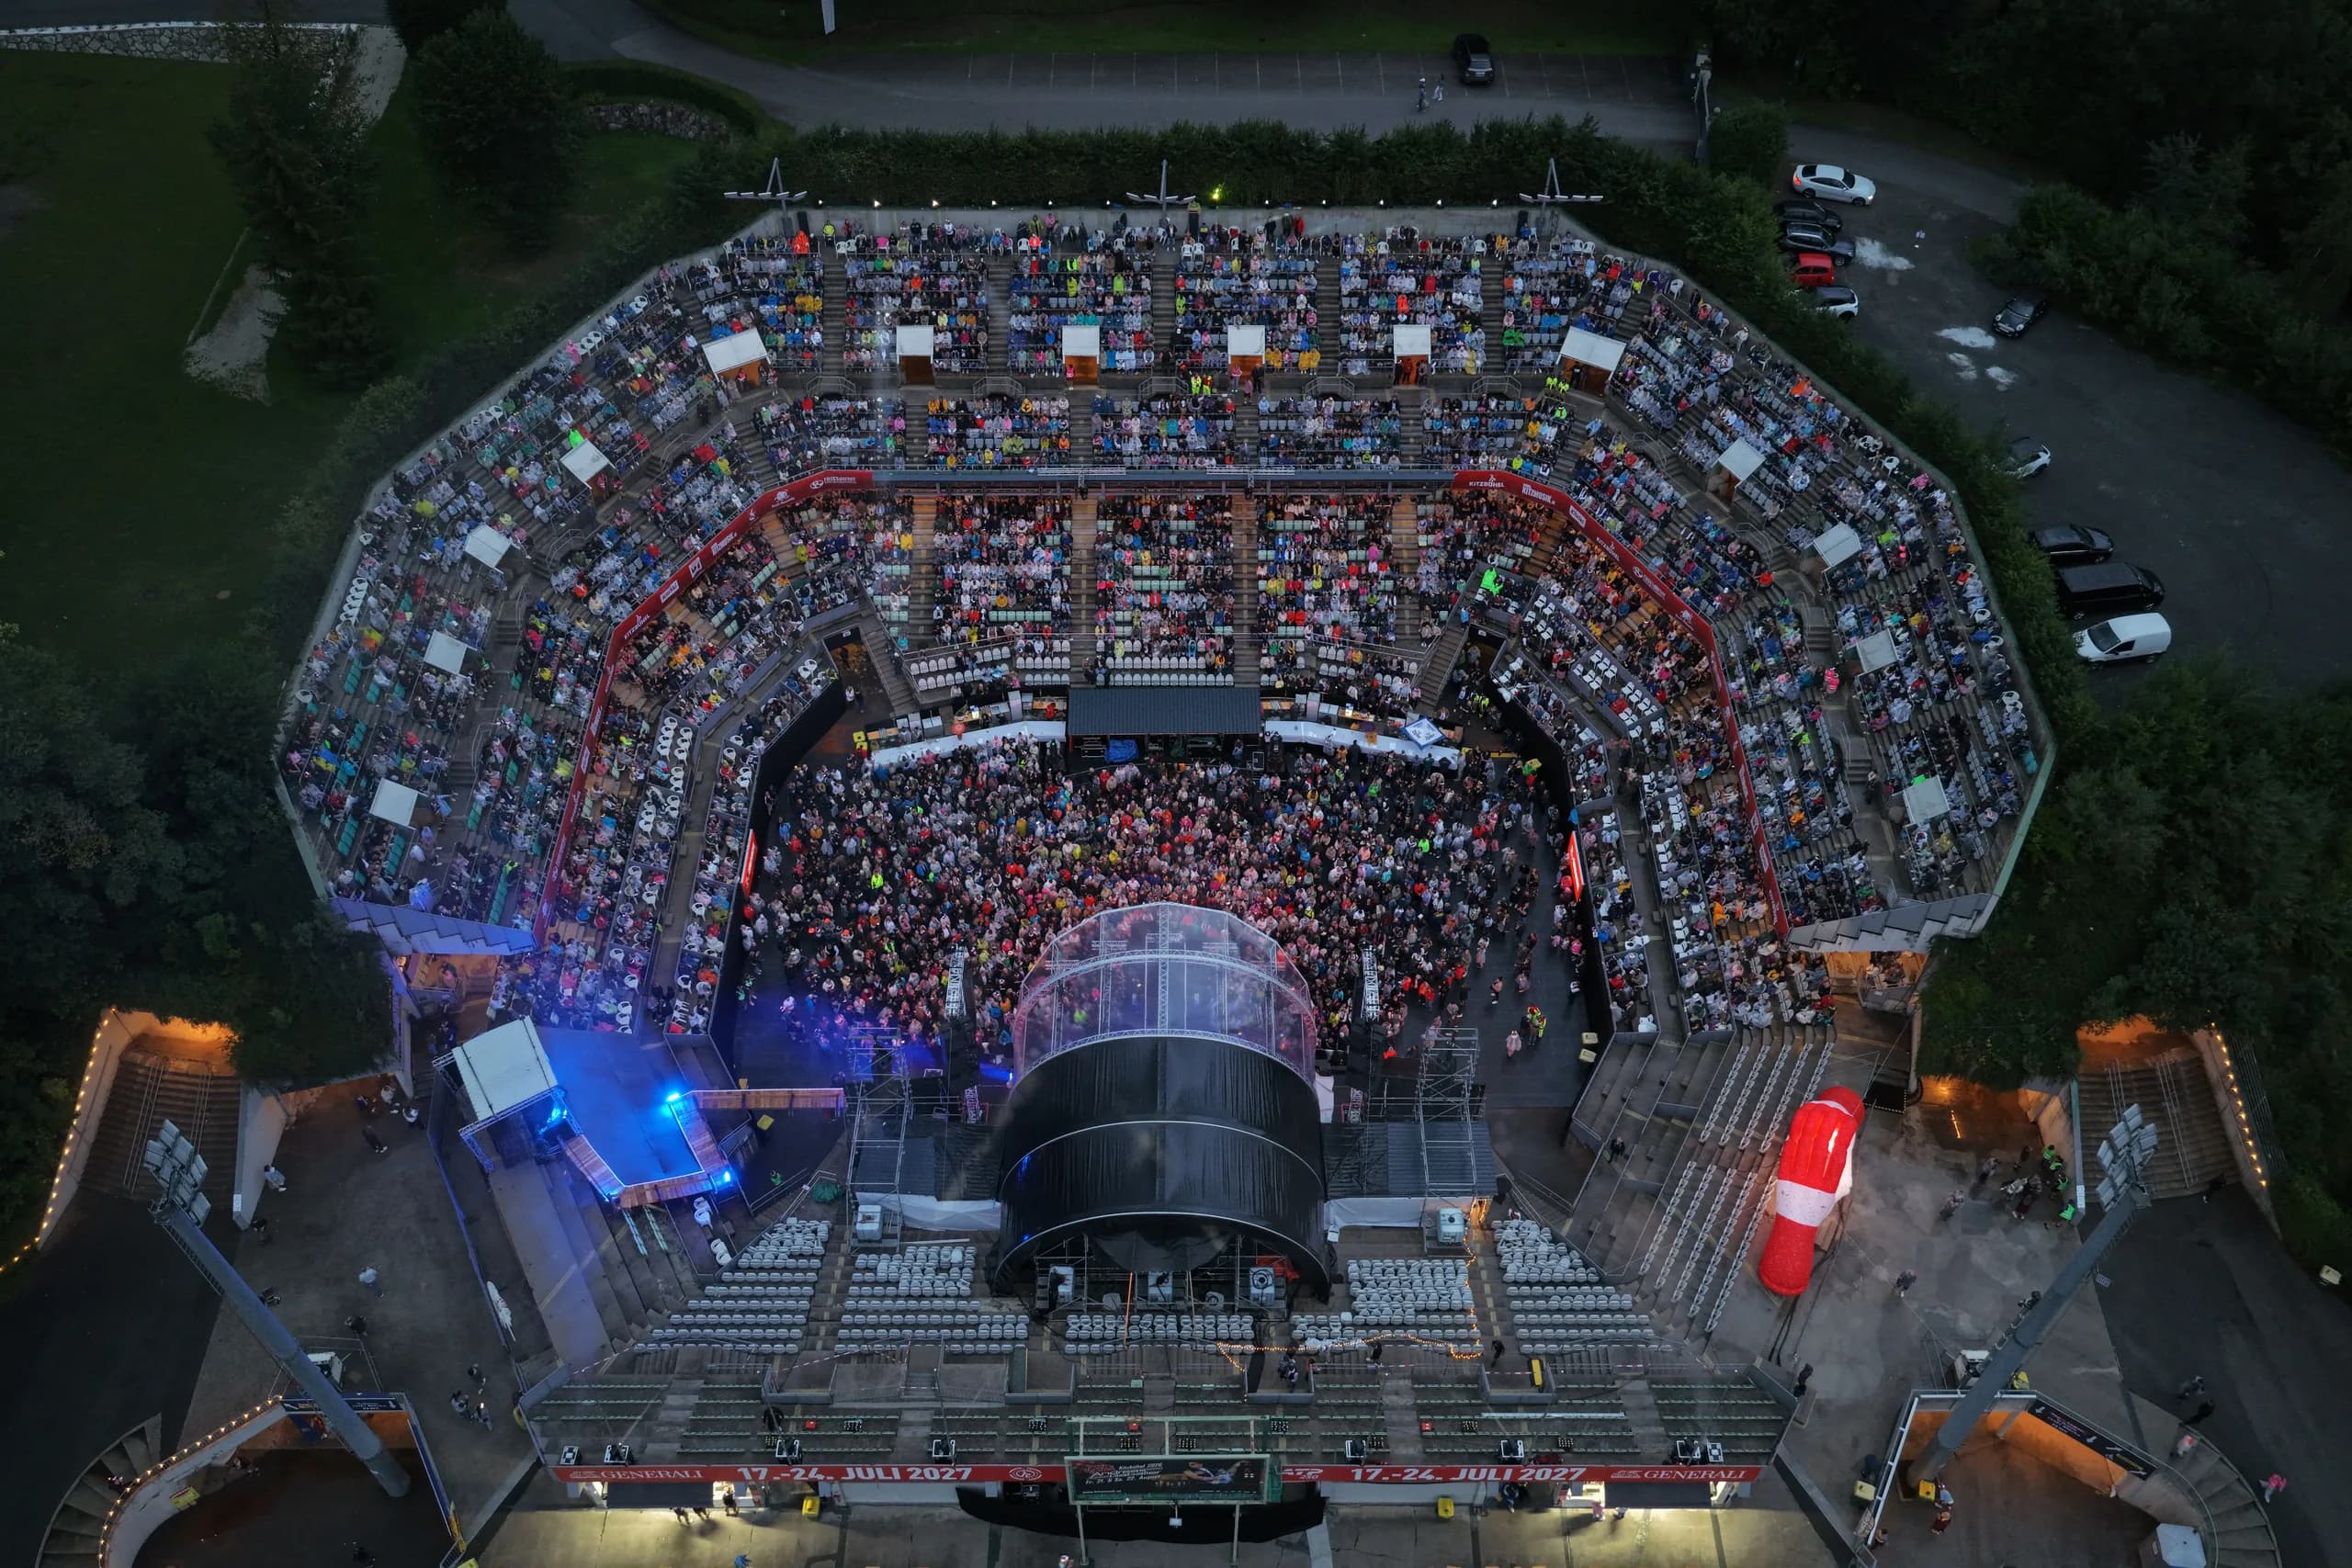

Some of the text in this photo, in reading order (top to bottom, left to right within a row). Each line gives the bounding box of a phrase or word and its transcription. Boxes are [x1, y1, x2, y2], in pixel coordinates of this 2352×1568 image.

[601, 1470, 704, 1479] GENERALI
[841, 1467, 901, 1481] JULI
[906, 1467, 973, 1481] 2027
[1449, 1468, 1514, 1481] JULI
[1517, 1468, 1588, 1481] 2027
[1644, 1470, 1747, 1479] GENERALI
